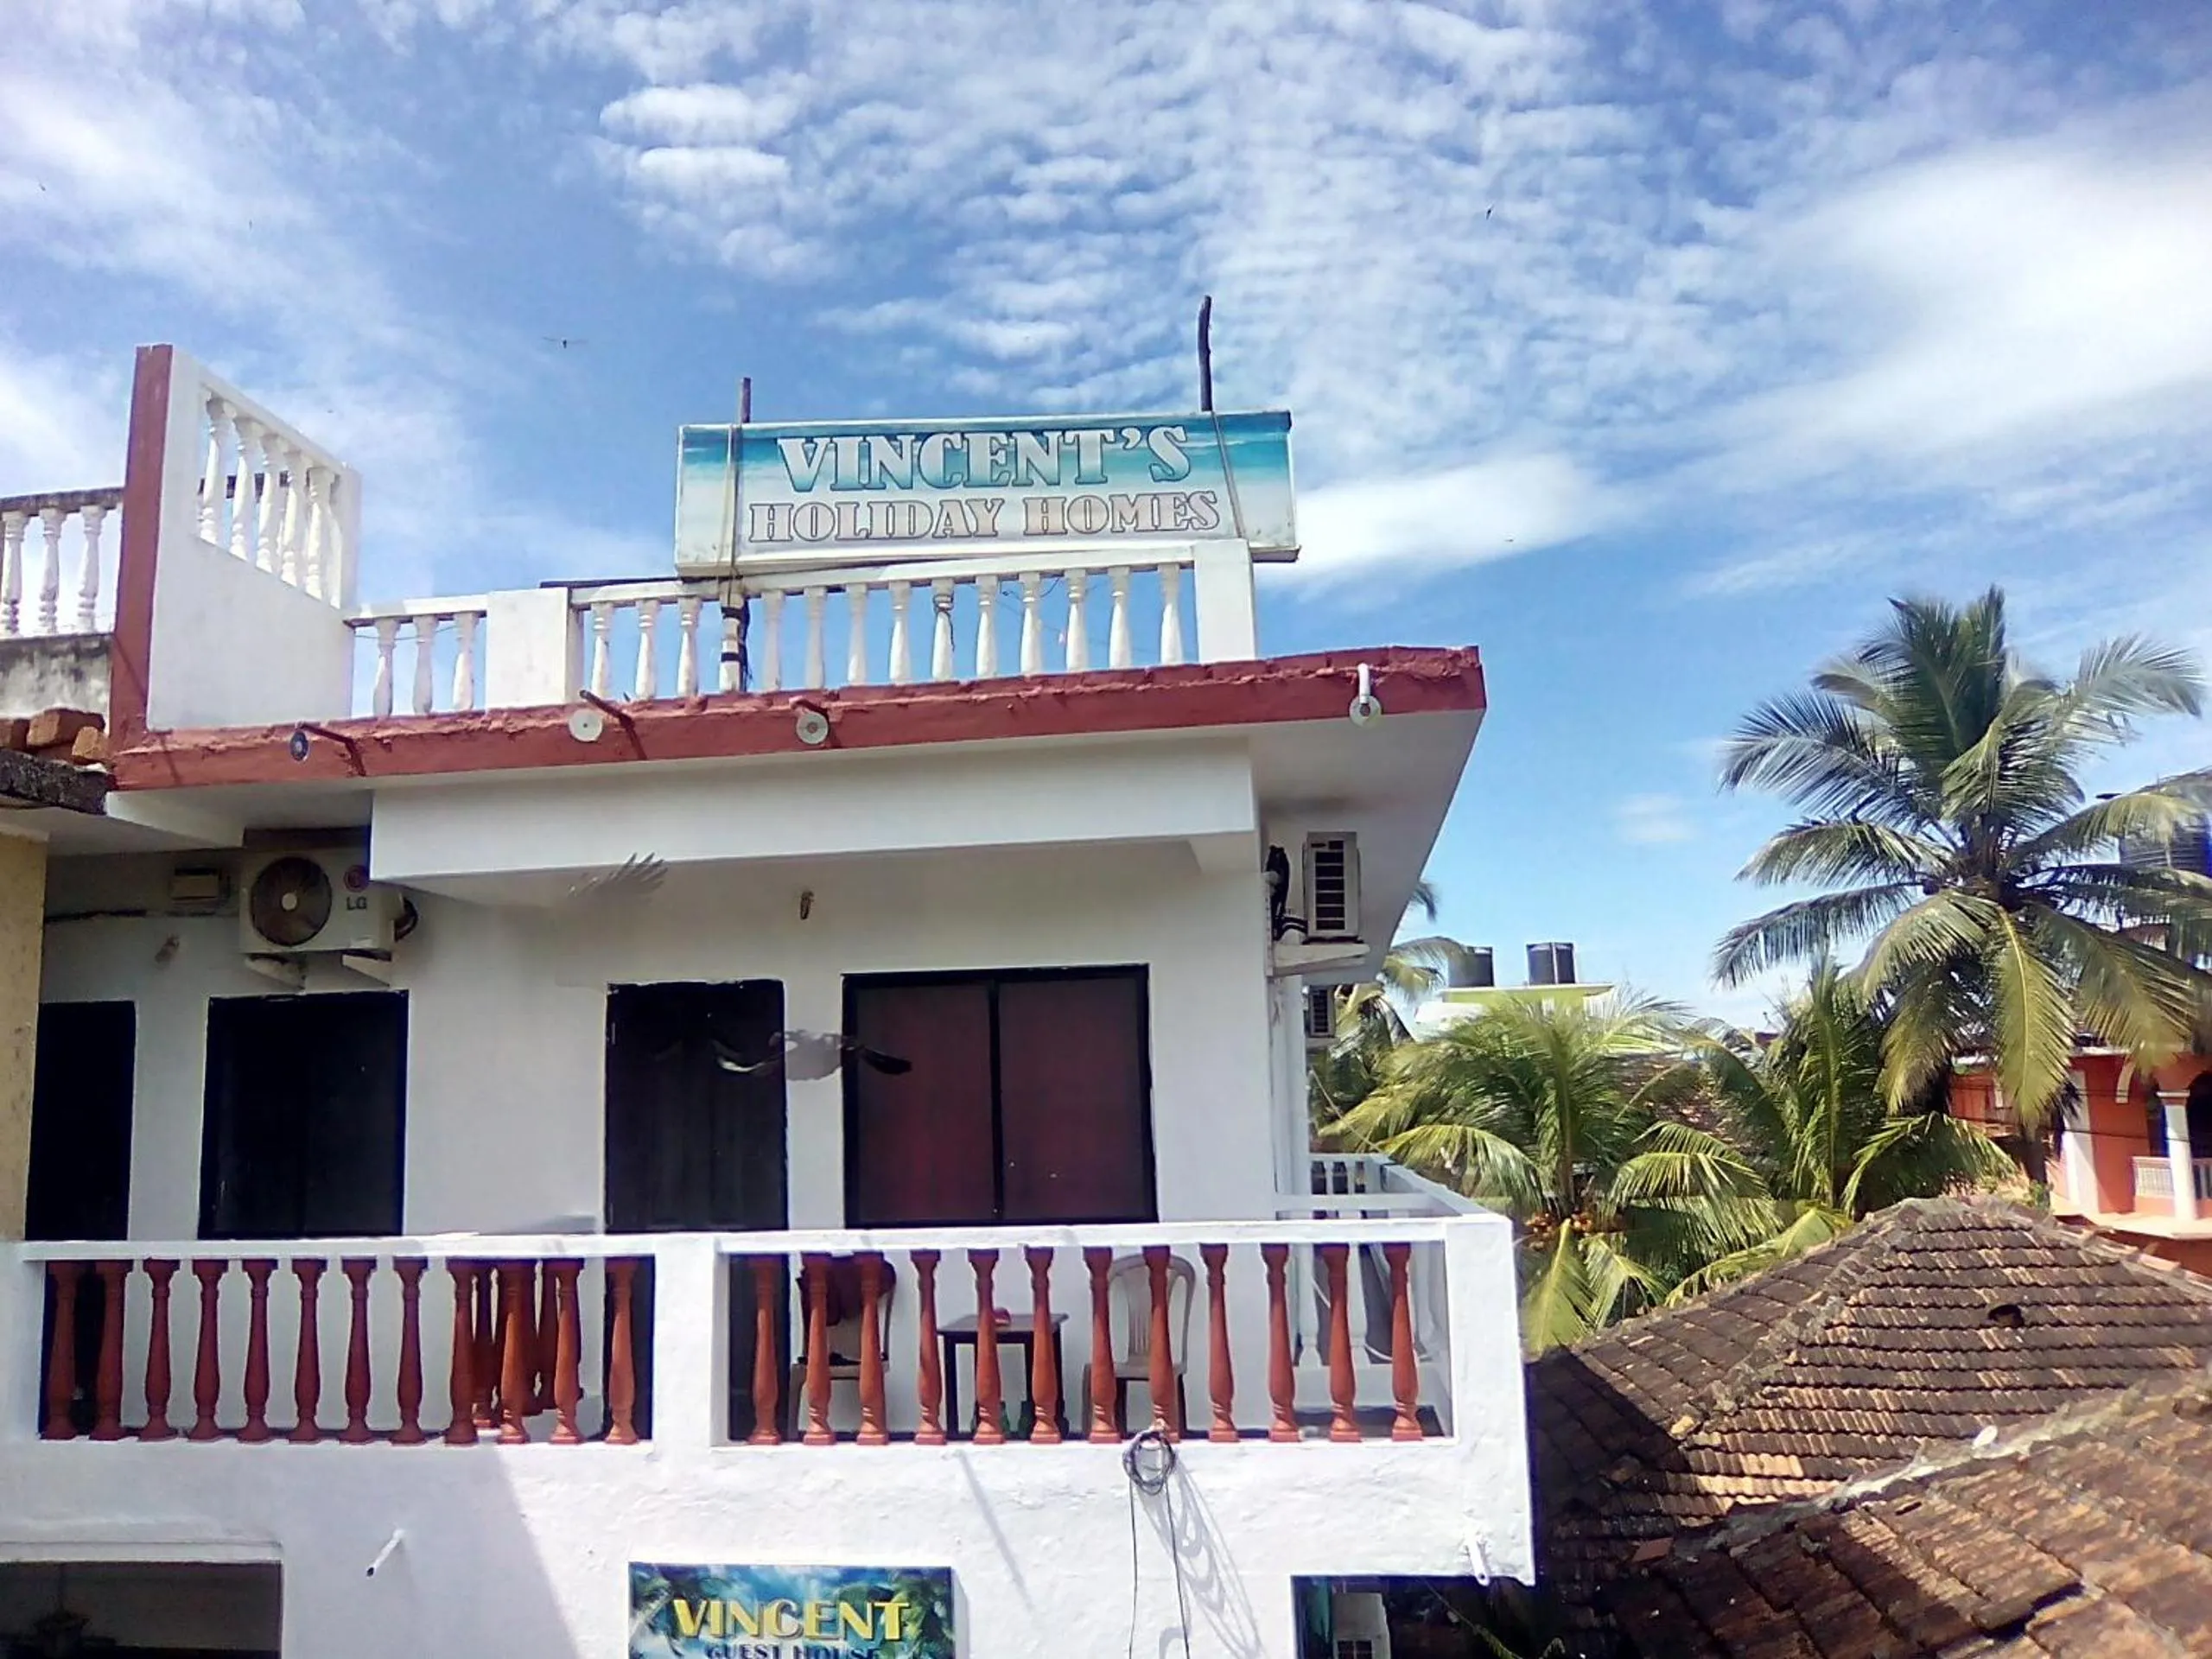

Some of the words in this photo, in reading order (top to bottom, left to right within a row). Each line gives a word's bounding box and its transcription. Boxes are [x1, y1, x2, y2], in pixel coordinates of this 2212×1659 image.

[776, 425, 1192, 493] VINCENT'S
[749, 499, 1006, 543] HOLIDAY
[1023, 491, 1221, 537] HOMES
[346, 896, 367, 910] LG
[672, 1598, 911, 1640] VINCENT
